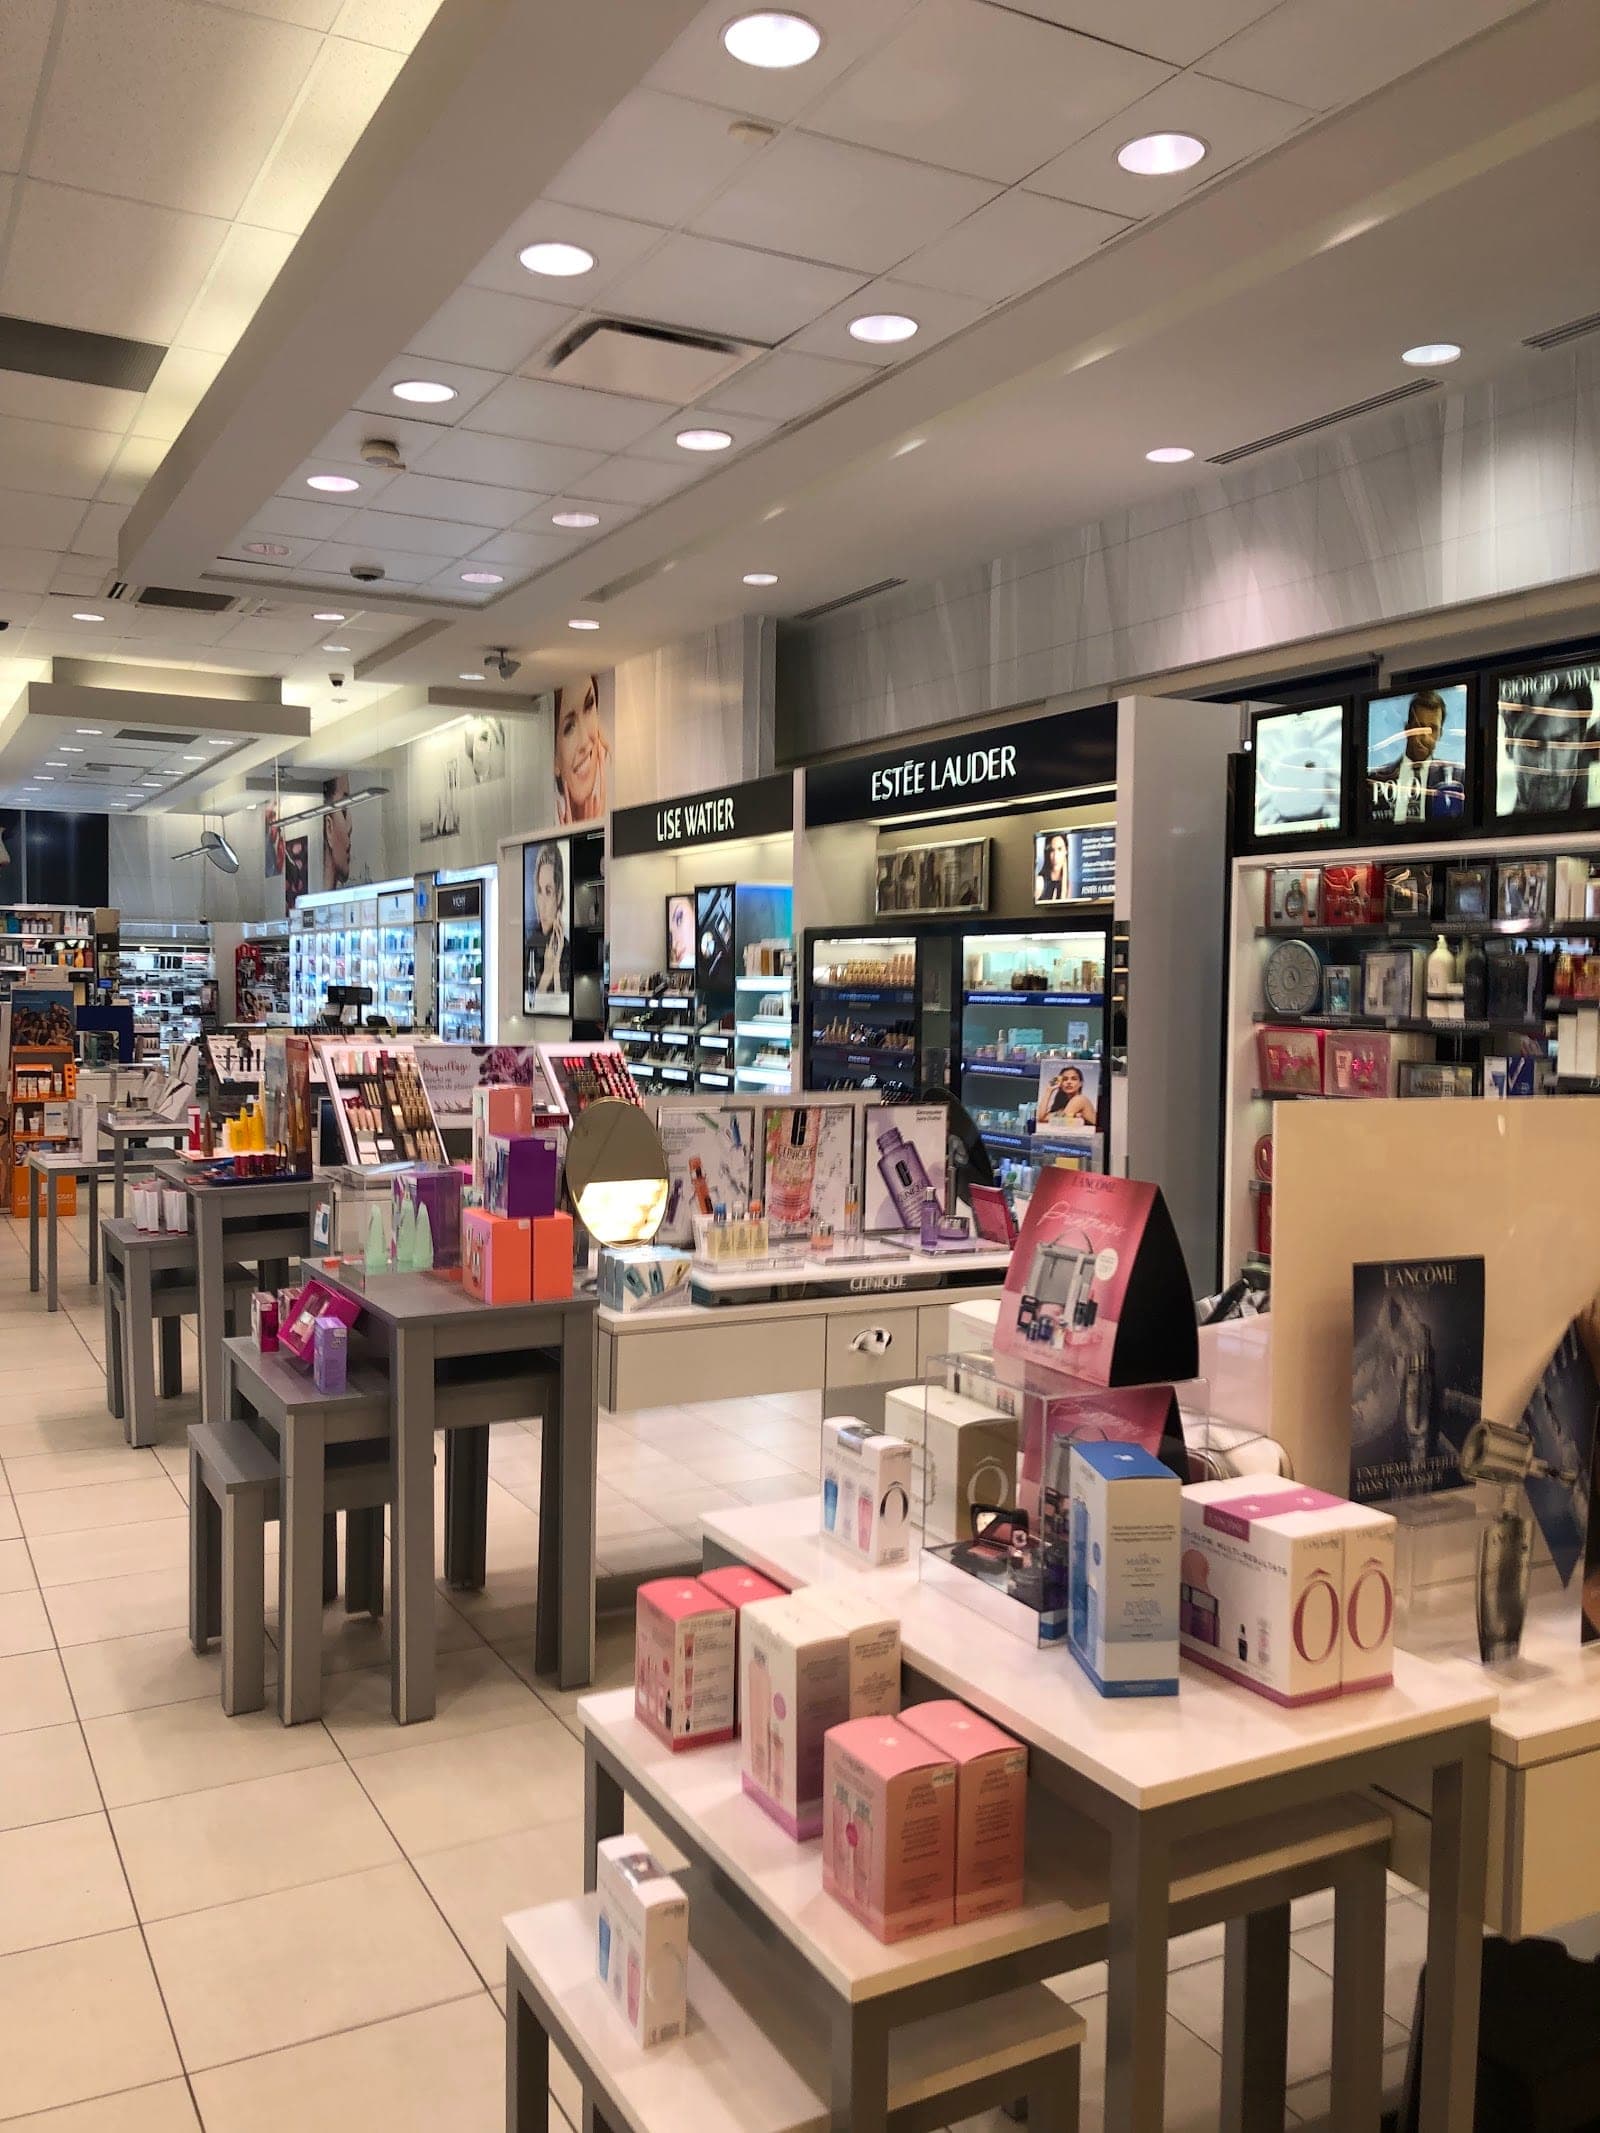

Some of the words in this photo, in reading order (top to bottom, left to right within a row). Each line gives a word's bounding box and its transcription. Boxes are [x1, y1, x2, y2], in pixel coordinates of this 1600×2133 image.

[1502, 673, 1559, 698] GIORGIO
[930, 745, 1017, 791] LAUDER
[1372, 776, 1422, 805] POO
[656, 808, 682, 842] LISE
[685, 797, 735, 837] WATIER
[850, 1275, 907, 1291] CLINIQUE
